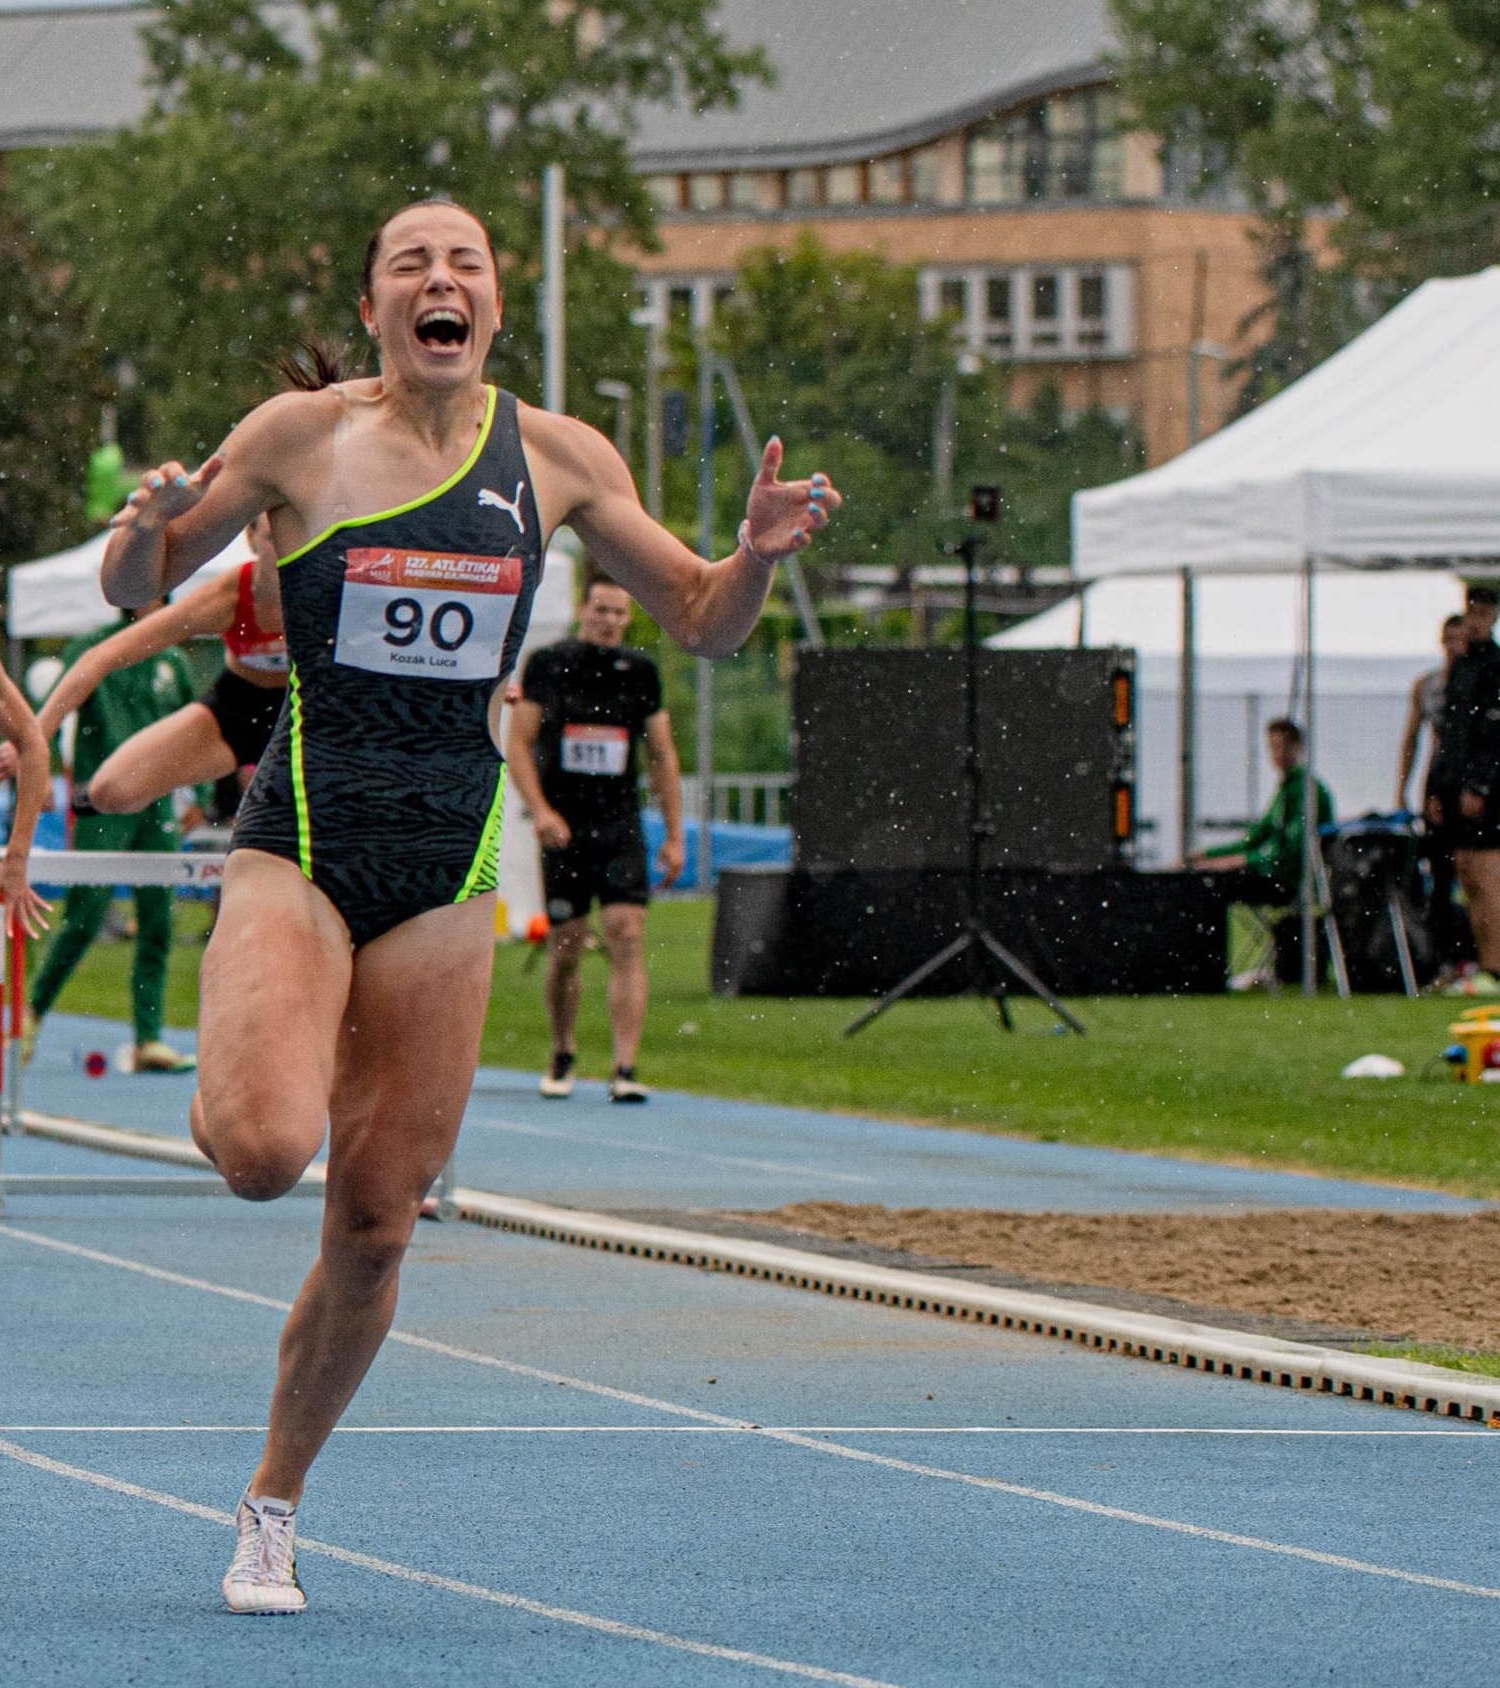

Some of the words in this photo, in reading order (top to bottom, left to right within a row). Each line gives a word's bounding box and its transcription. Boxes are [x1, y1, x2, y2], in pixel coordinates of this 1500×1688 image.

[404, 556, 429, 569] 127.
[431, 557, 500, 574] ATLÉTIKAI
[383, 597, 474, 652] 90
[390, 652, 425, 666] Kozák
[429, 656, 457, 668] Luca
